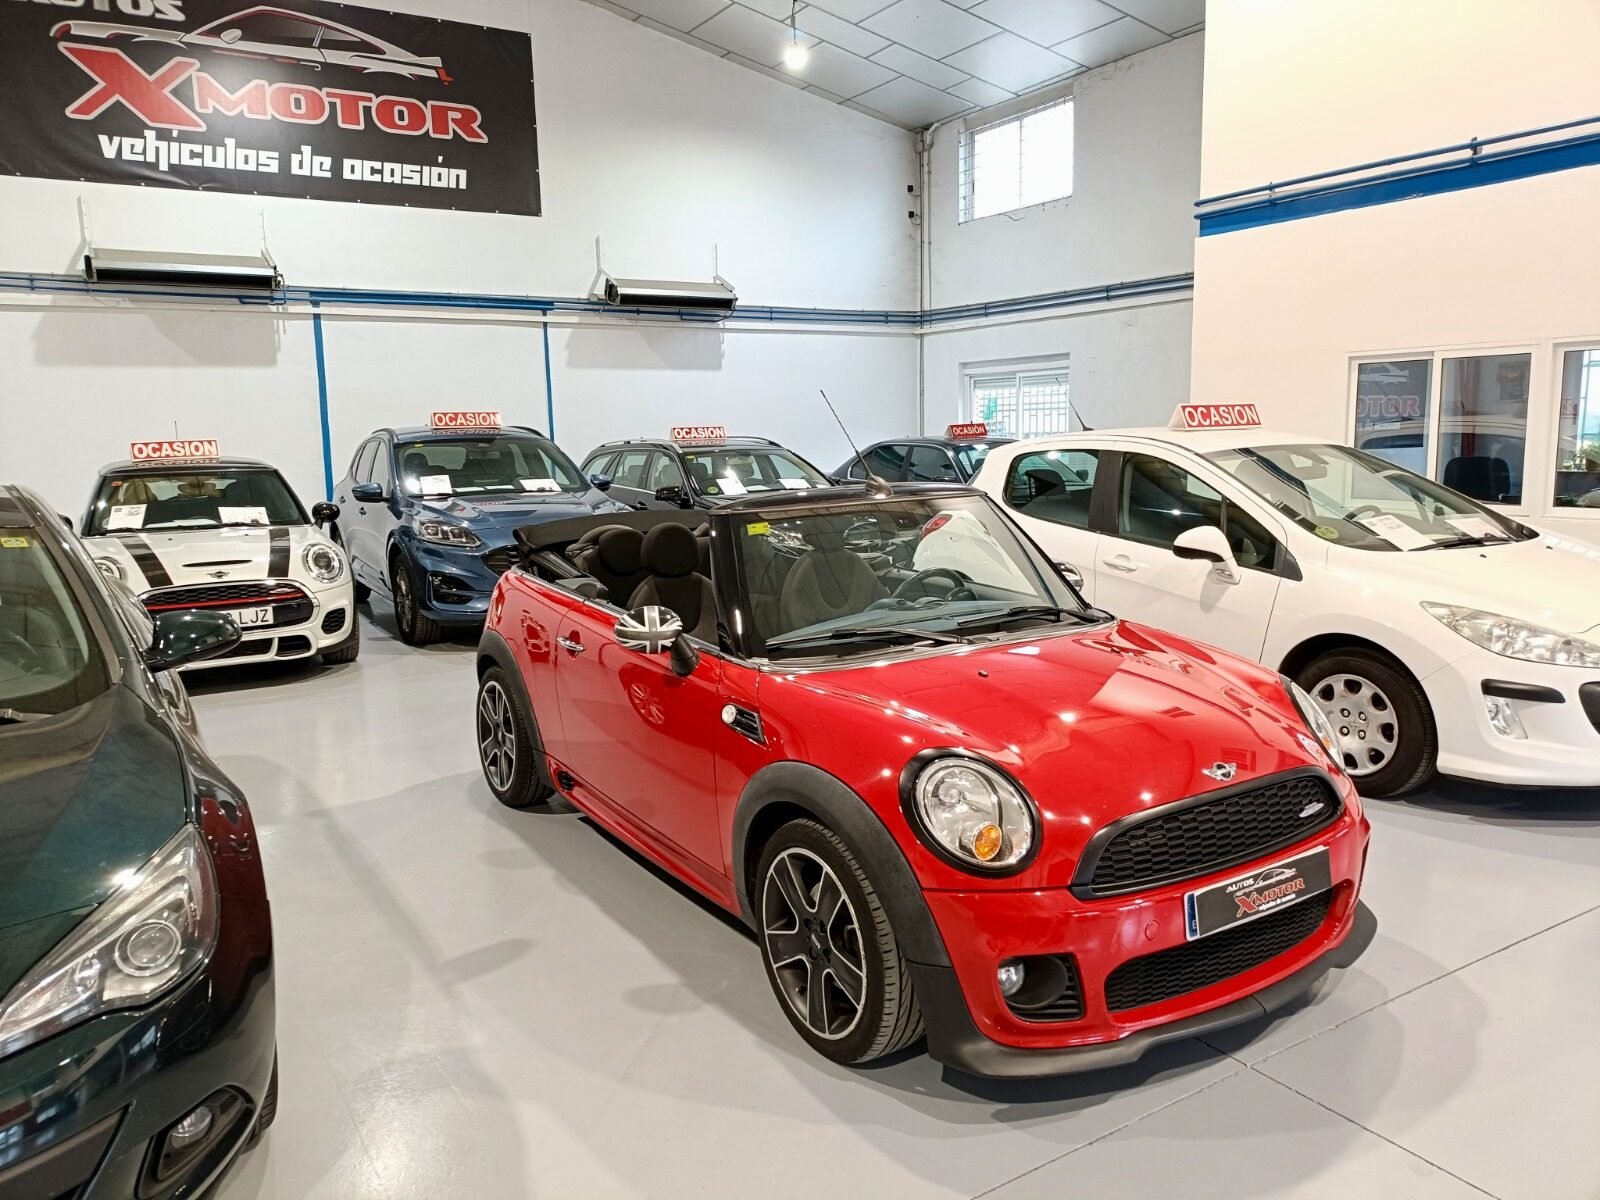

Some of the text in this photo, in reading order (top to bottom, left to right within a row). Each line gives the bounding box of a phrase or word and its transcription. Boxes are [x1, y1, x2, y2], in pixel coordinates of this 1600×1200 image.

[57, 41, 489, 143] XMOTOR
[98, 129, 467, 190] vehículos de ocasión
[434, 413, 500, 426] OCASION
[1184, 405, 1260, 426] OCASION
[674, 427, 725, 439] OCASION
[133, 440, 218, 459] OCASION
[239, 609, 269, 625] LJZ
[1225, 878, 1255, 894] AUTOS
[1234, 878, 1305, 918] XMOTOR
